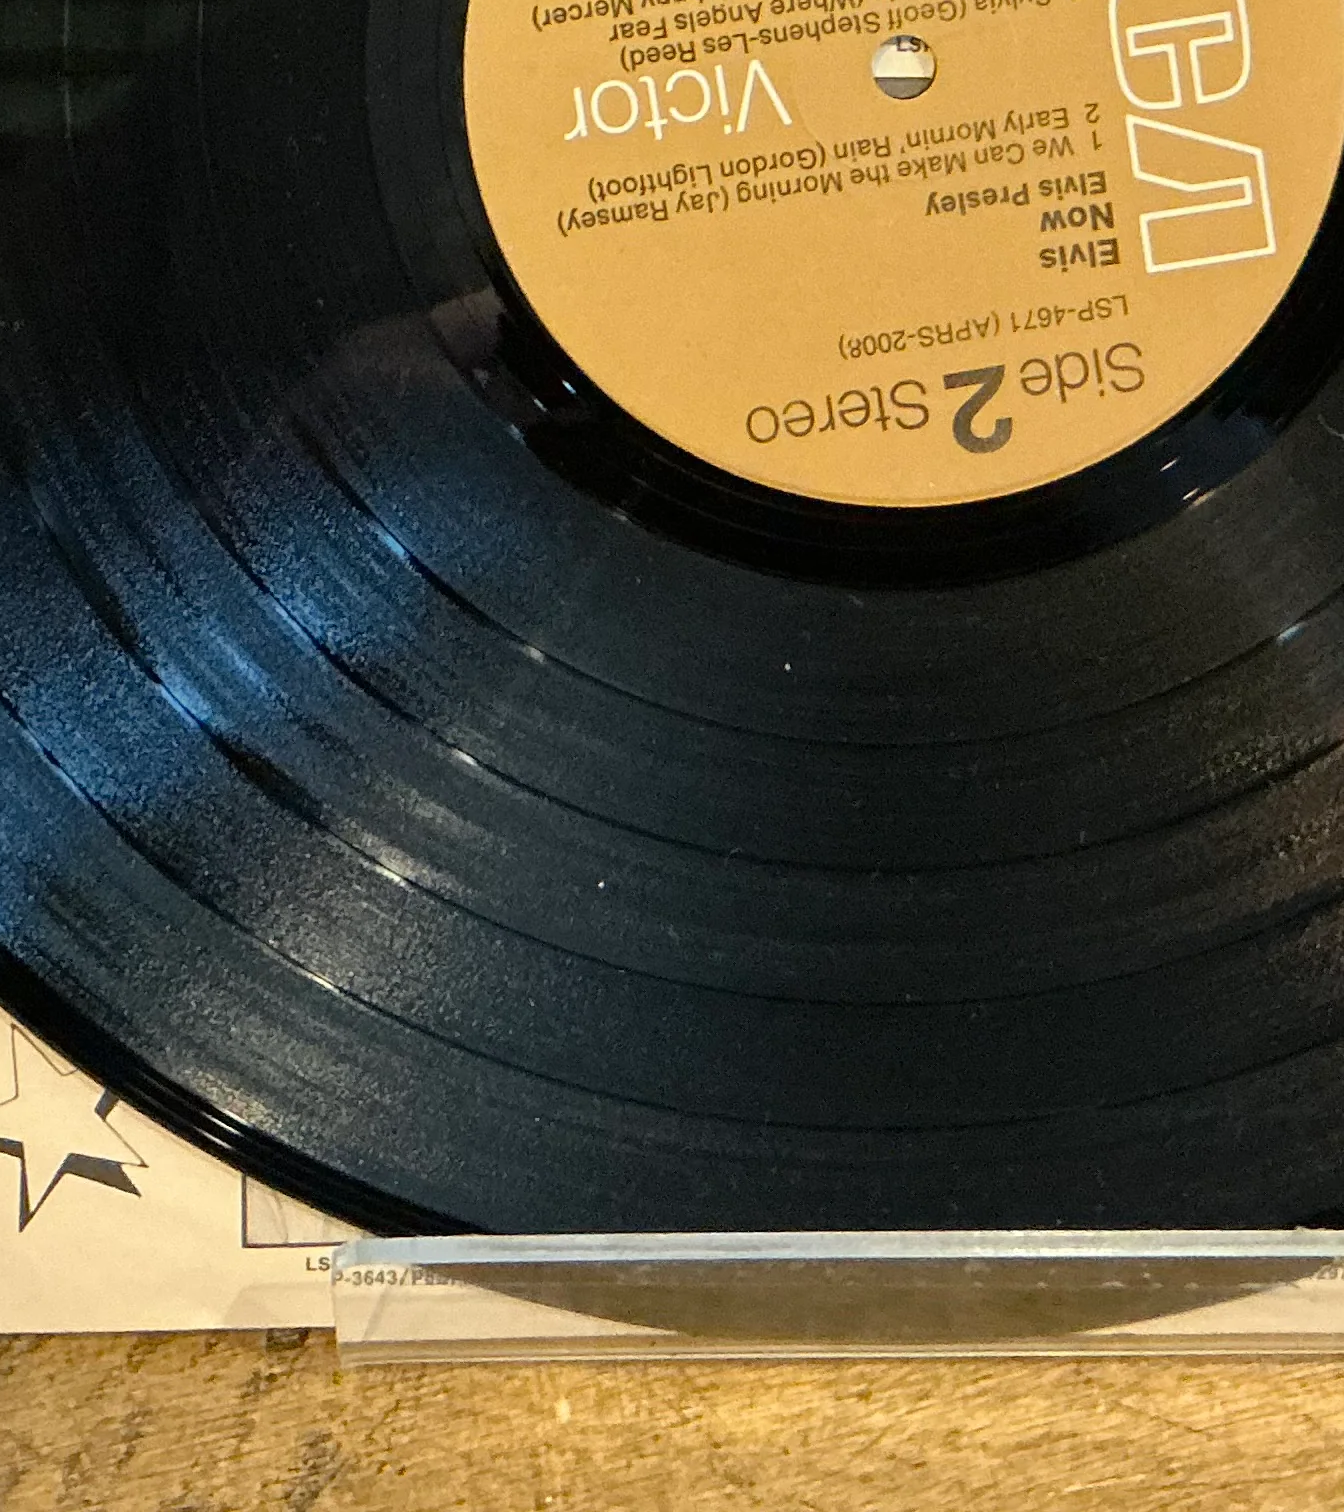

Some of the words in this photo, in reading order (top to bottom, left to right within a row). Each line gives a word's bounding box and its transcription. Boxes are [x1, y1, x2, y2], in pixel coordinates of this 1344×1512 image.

[607, 15, 669, 42] Fear
[673, 0, 763, 34] Angels
[701, 10, 881, 54] Stephens-Les
[619, 39, 697, 73] Reed)
[563, 58, 793, 141] Victor
[1002, 106, 1070, 136] Early
[718, 140, 827, 178] (Gordon
[832, 134, 892, 163] Rain
[972, 141, 1025, 165] Can
[1031, 134, 1075, 159] We
[848, 162, 891, 187] the
[895, 150, 967, 180] Make
[587, 162, 713, 205] Lightfoot)
[674, 184, 730, 214] (Jay
[734, 170, 843, 204] Morning
[924, 181, 1031, 217] Presley
[1036, 169, 1107, 202] Elvis
[556, 198, 670, 238] Ramsey)
[1039, 200, 1115, 233] Now
[1037, 236, 1121, 273] Elvis
[1009, 293, 1129, 333] LSP-4671
[837, 309, 1001, 361] (APRS-2008)
[1018, 340, 1145, 404] Side
[744, 378, 930, 444] Stereo
